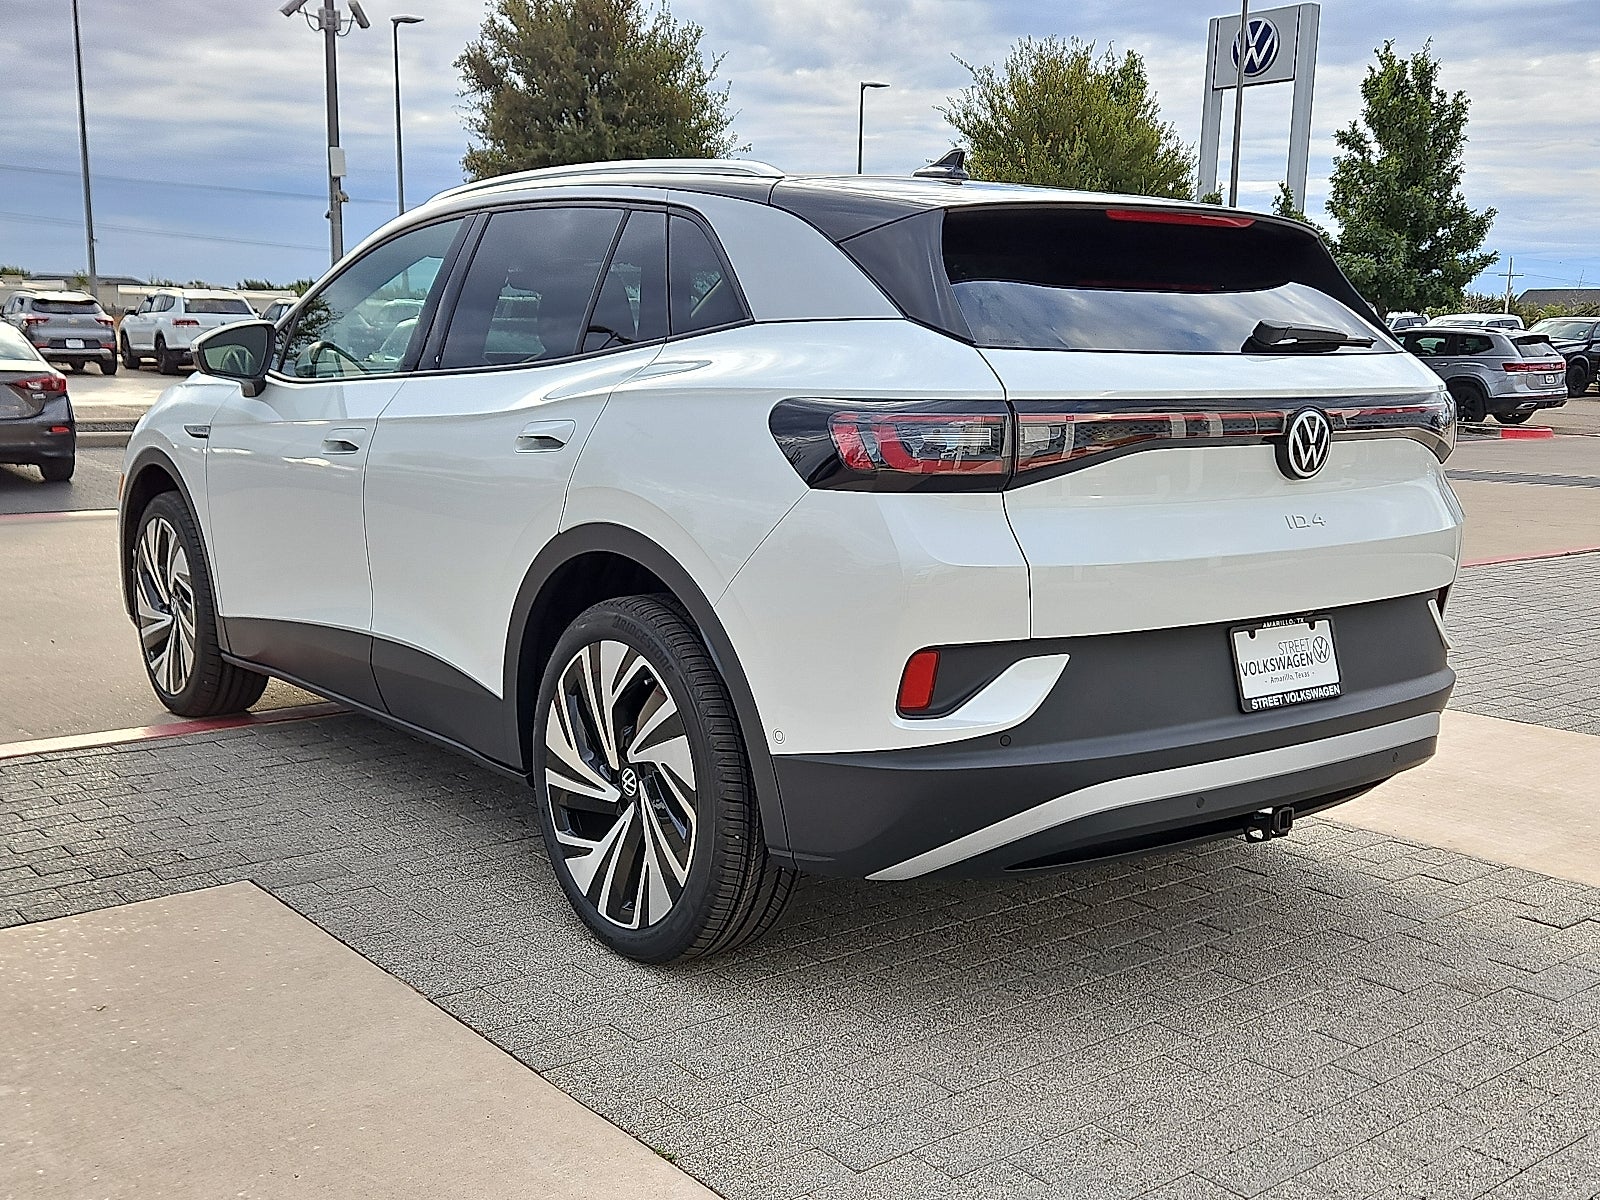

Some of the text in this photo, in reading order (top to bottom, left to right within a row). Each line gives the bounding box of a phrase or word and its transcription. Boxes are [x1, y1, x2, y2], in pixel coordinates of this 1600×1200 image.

[1289, 410, 1330, 477] VW
[1284, 513, 1326, 530] ID.4
[611, 614, 675, 675] BRIDGESTONE
[1278, 637, 1310, 656] STREET
[1240, 652, 1314, 677] VOLKSWAGEN
[1295, 671, 1310, 680] Texas
[1251, 684, 1341, 710] STREET VOLKSWAGEN
